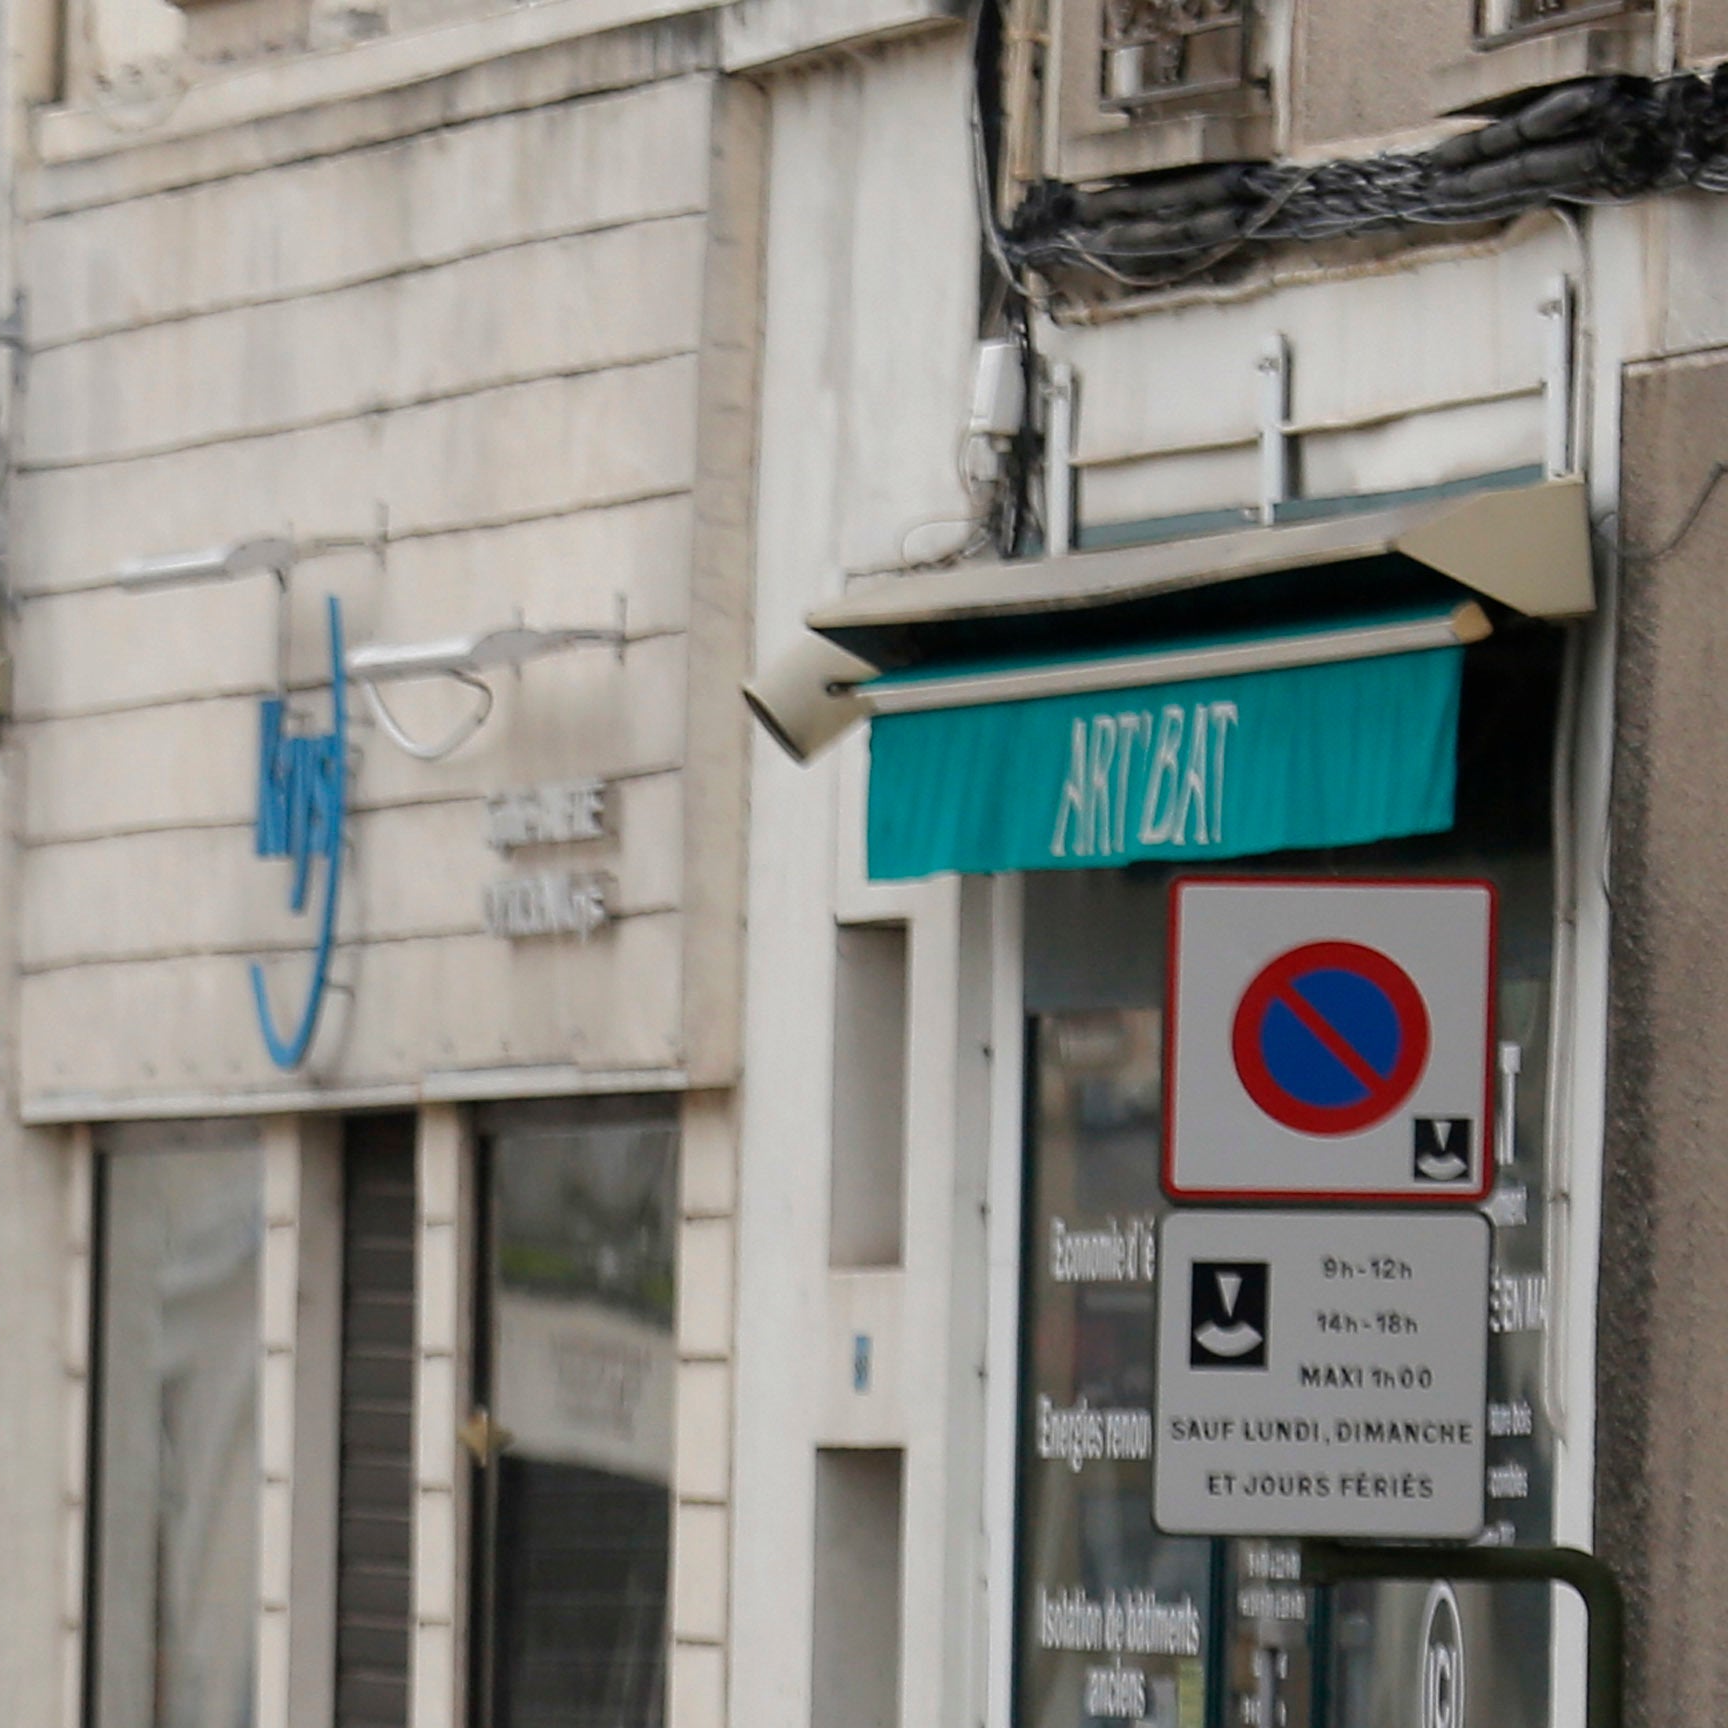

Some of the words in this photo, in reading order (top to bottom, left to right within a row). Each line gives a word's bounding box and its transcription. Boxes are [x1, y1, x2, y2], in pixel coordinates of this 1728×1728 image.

[1300, 1365, 1363, 1388] MAXI
[1372, 1367, 1433, 1390] 1h00
[1169, 1419, 1236, 1441] SAUF
[1337, 1421, 1473, 1445] DIMANCHE
[1207, 1474, 1236, 1496] ET
[1242, 1474, 1331, 1497] JOURS
[1341, 1470, 1434, 1498] FÉRIÉS
